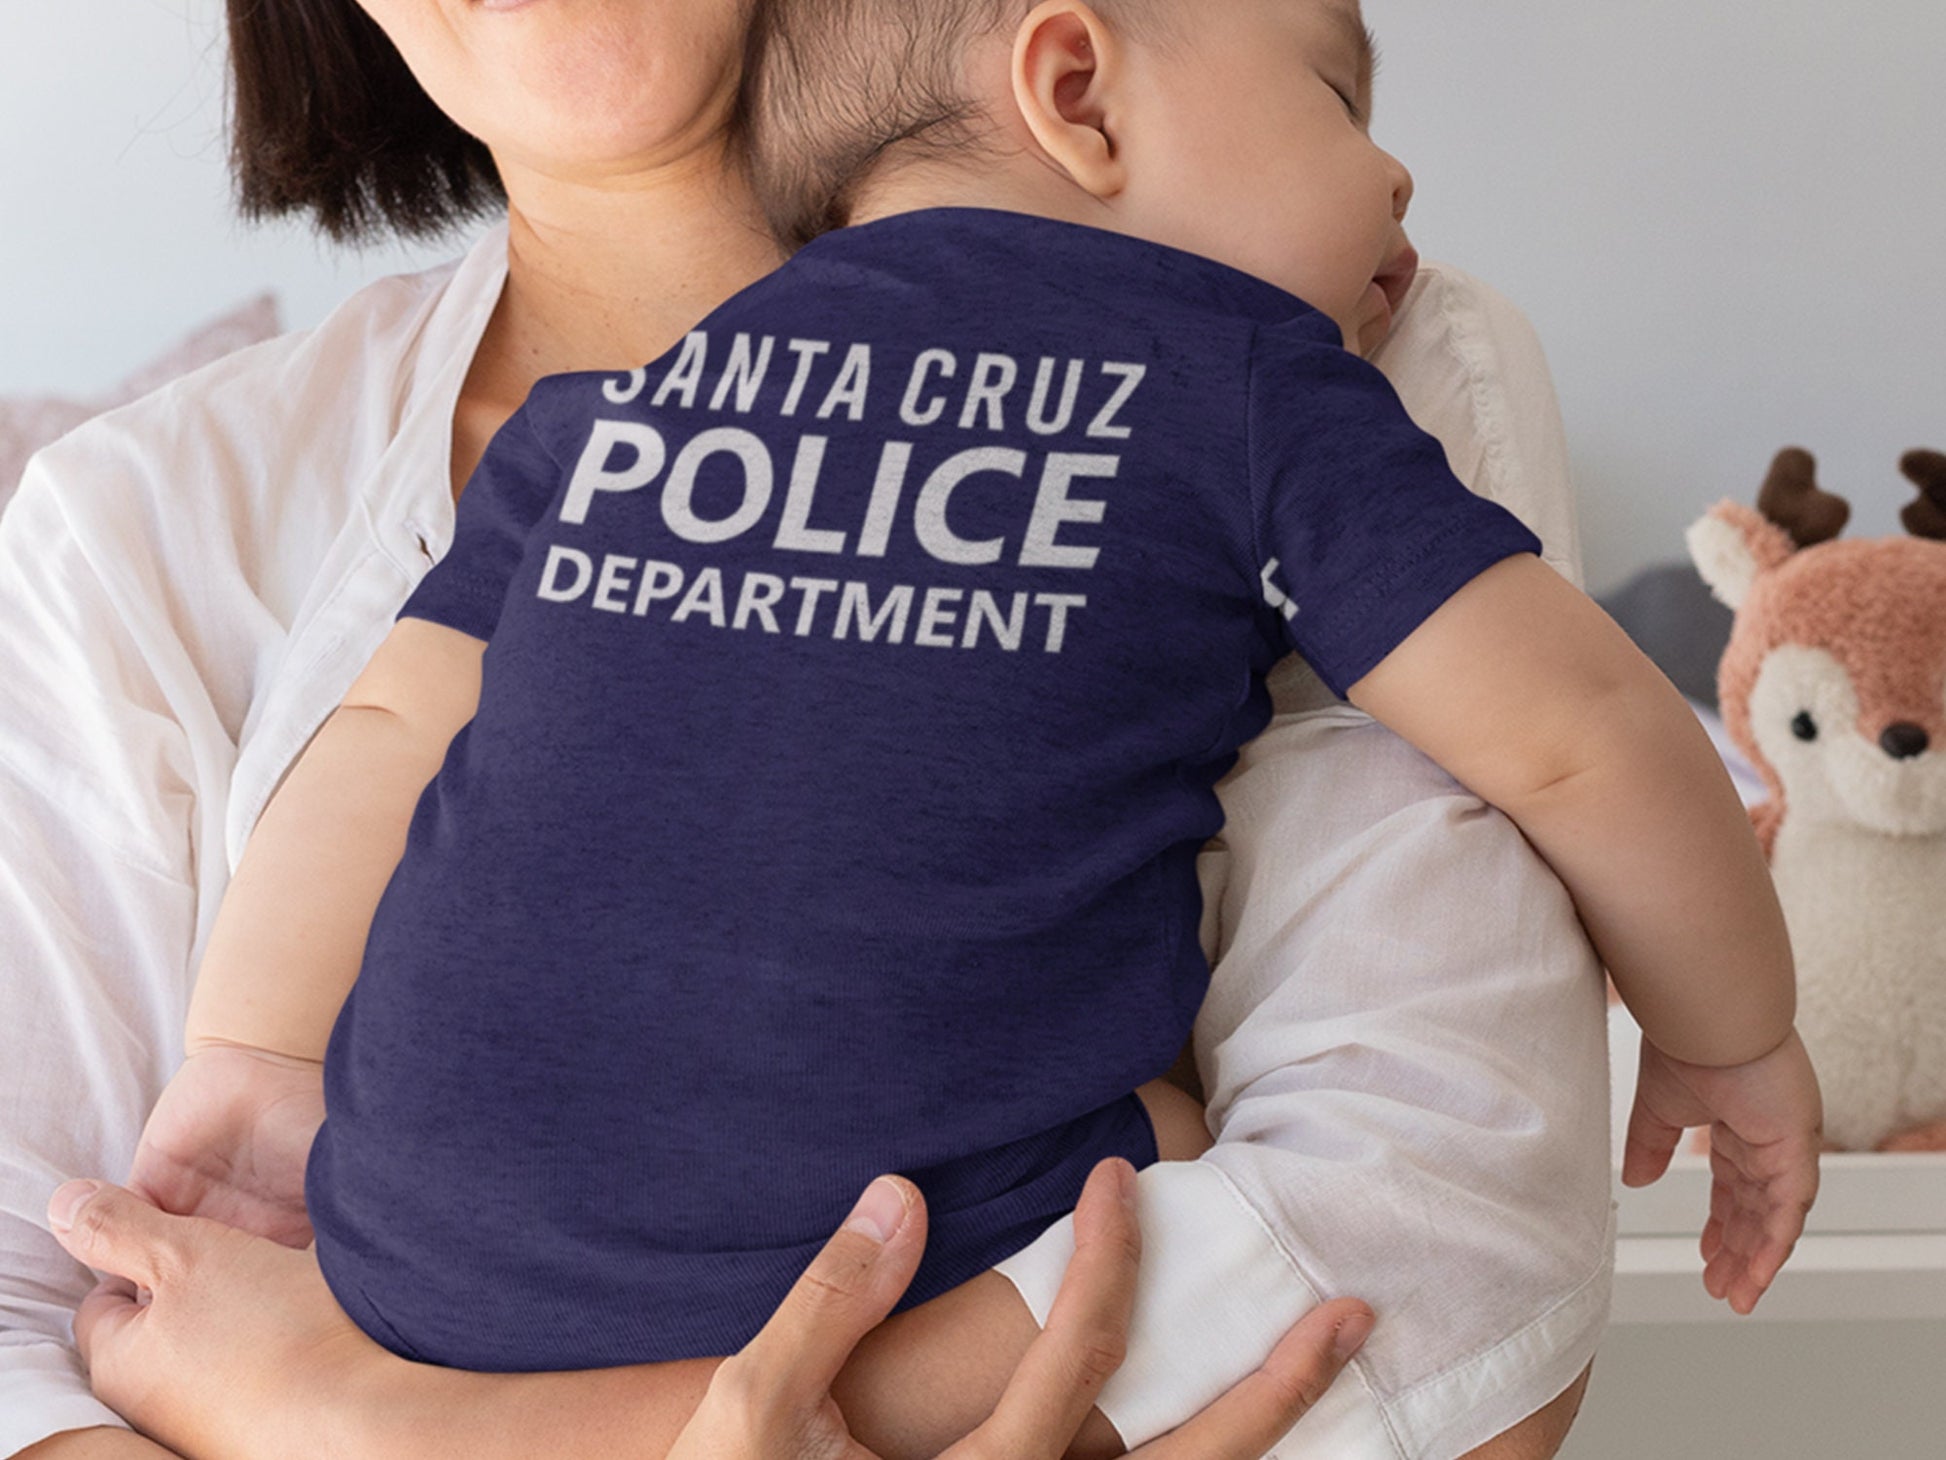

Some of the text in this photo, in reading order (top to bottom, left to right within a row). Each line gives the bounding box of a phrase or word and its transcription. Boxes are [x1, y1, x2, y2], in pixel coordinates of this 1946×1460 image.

[899, 348, 1147, 439] CRUZ
[558, 418, 1120, 569] POLICE
[536, 544, 1087, 653] DEPARTMENT
